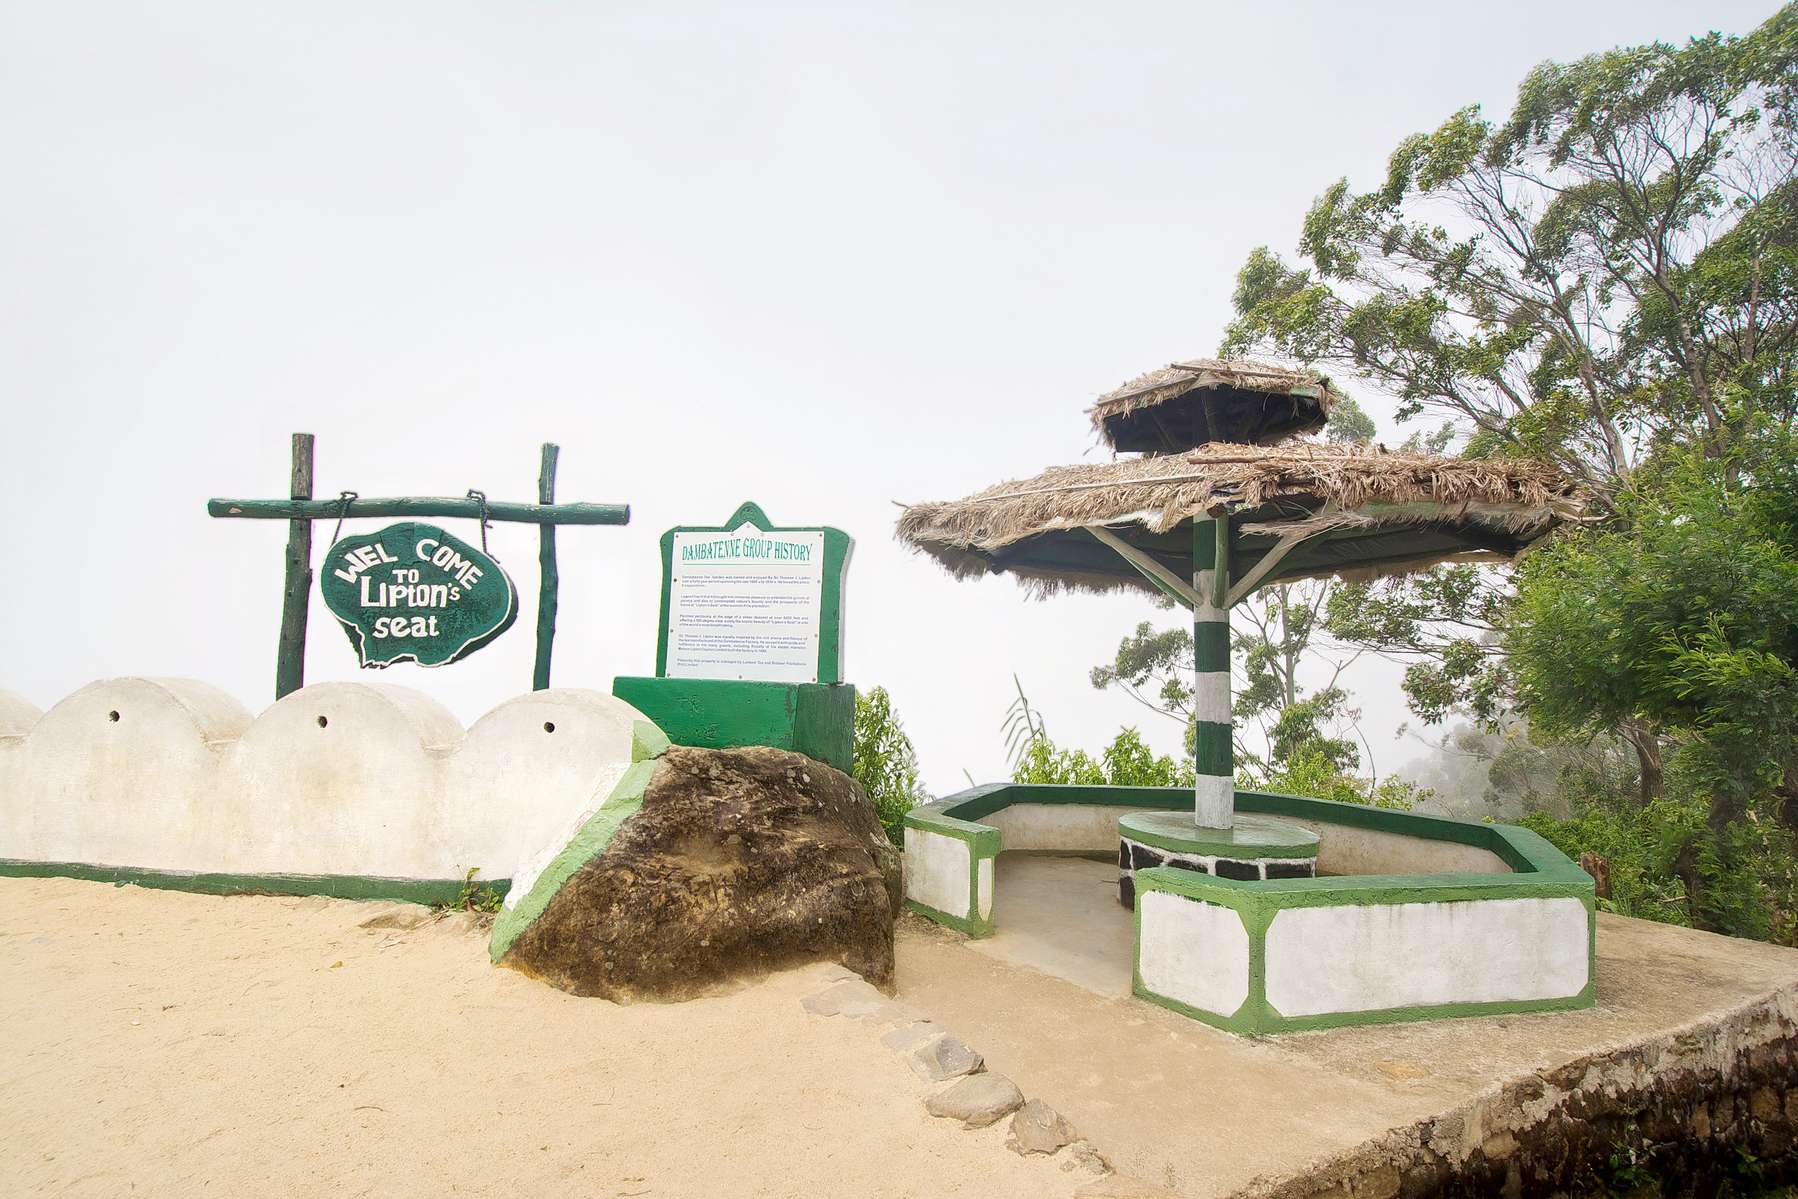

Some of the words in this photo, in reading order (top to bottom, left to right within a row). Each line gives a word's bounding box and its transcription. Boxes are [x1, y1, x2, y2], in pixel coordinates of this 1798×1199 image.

[682, 538, 741, 560] DAMBATENNE
[743, 537, 773, 558] GROUP
[774, 542, 813, 561] HISTORY
[334, 543, 398, 584] WEL
[415, 538, 484, 590] COME
[392, 568, 419, 583] TO
[372, 615, 439, 638] seat
